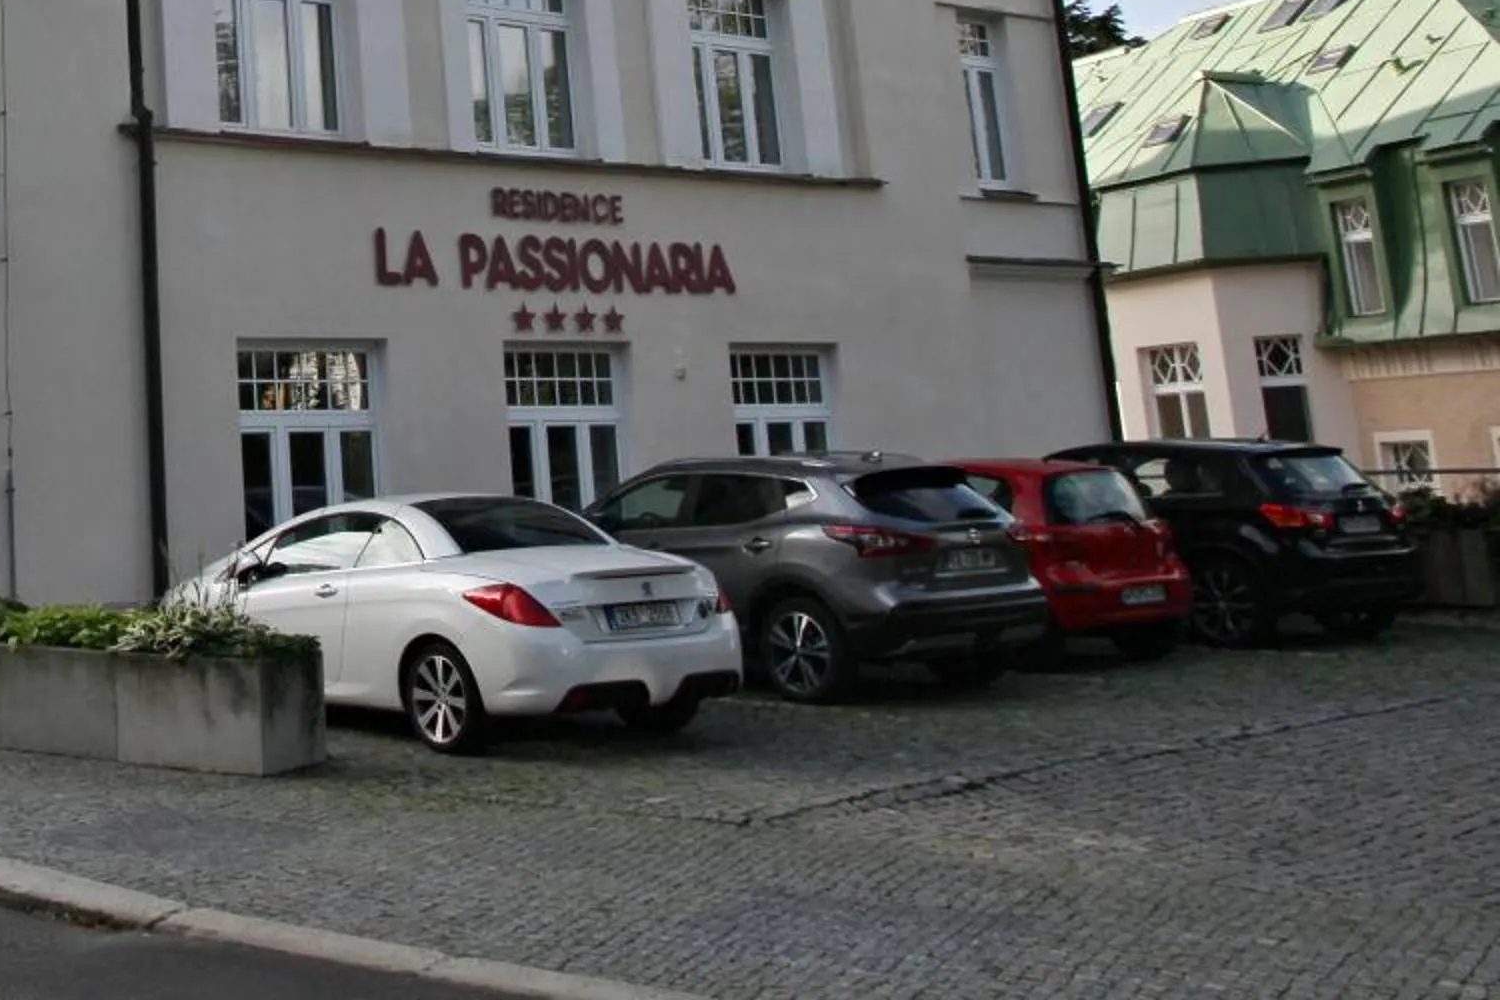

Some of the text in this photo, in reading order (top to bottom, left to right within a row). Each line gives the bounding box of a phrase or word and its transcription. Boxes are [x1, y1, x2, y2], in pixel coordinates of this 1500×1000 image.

[490, 186, 624, 226] RESIDENCE
[374, 226, 737, 295] LA PASSIONARIA
